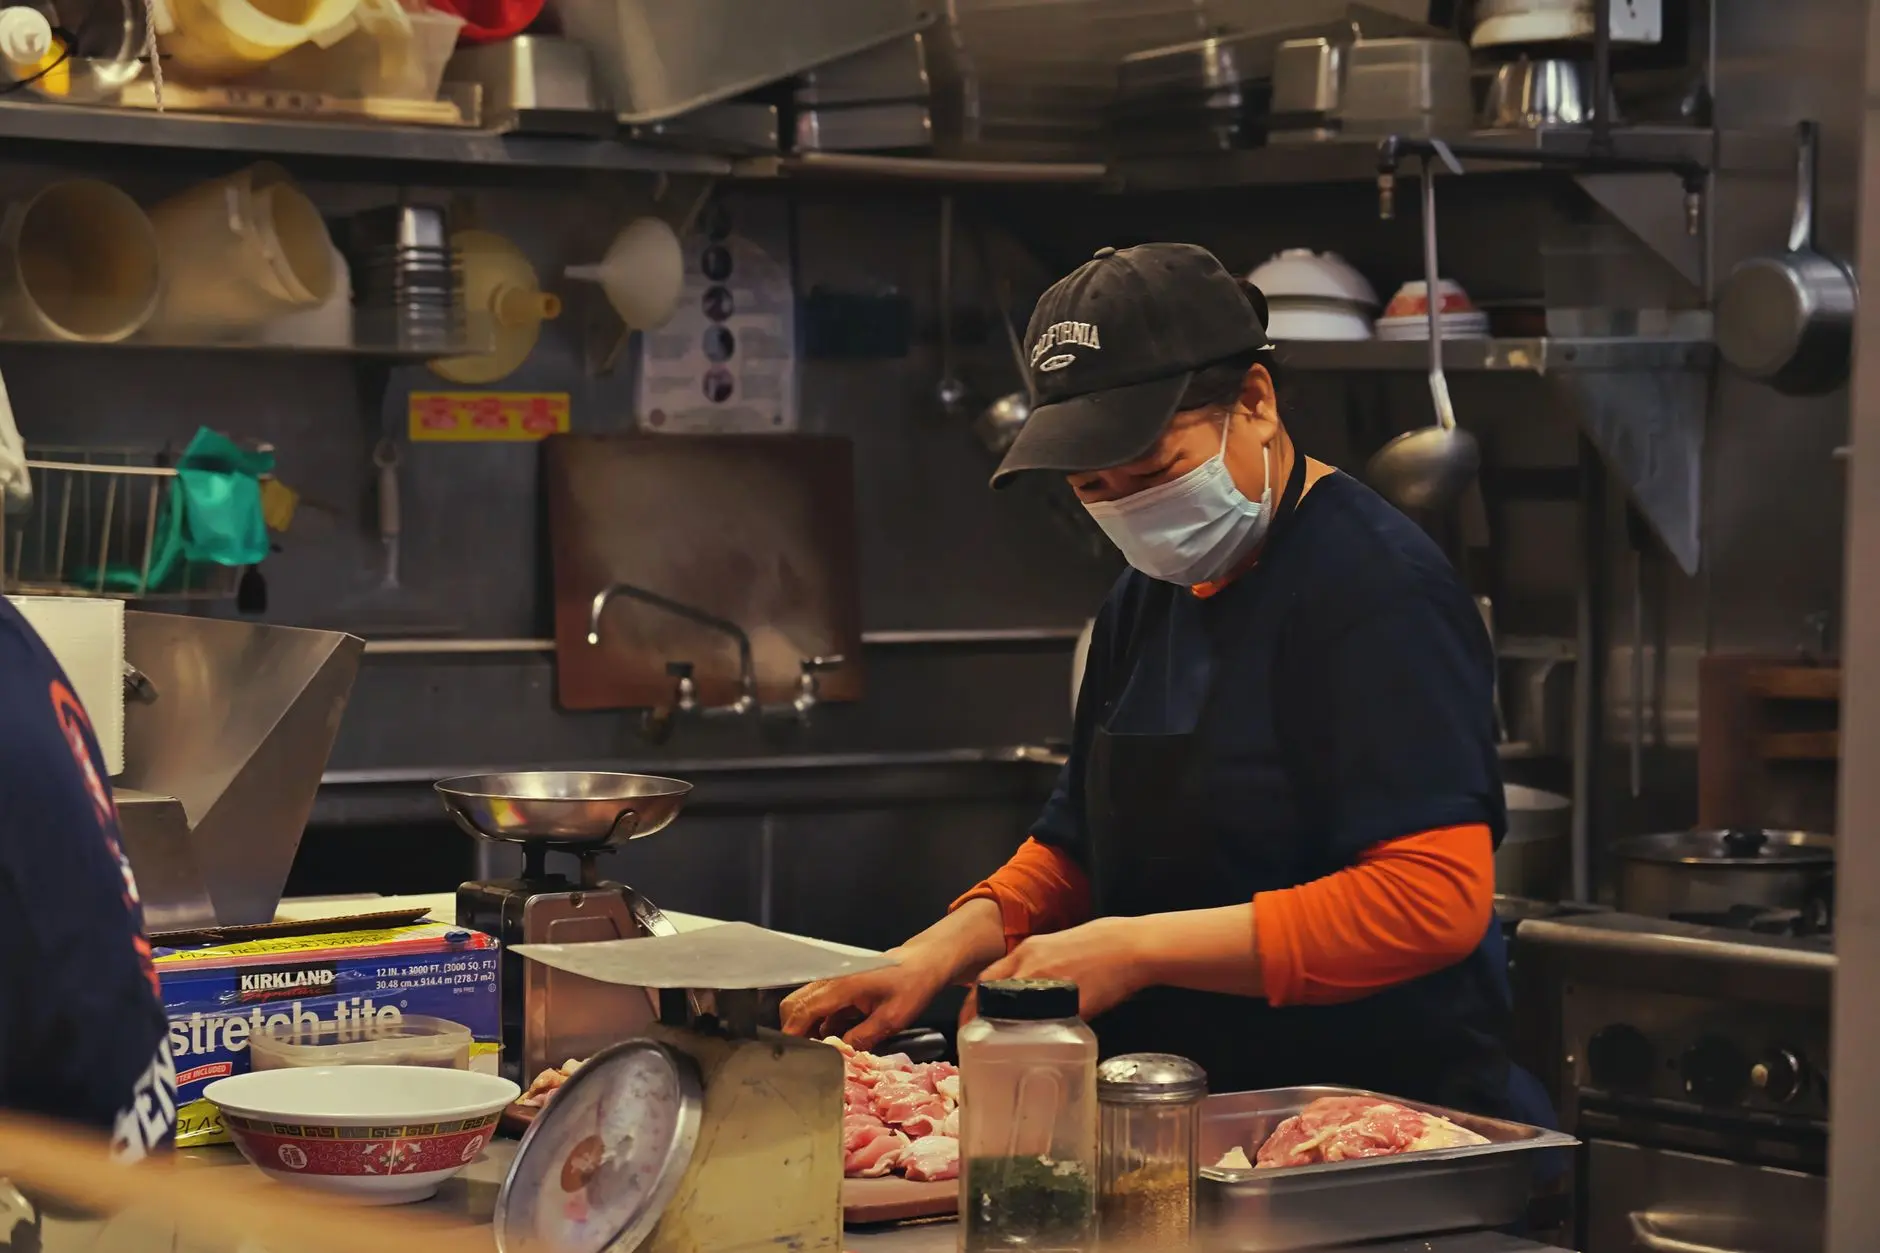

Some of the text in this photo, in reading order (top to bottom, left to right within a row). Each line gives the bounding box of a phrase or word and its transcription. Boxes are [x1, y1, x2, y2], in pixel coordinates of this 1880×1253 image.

[376, 960, 496, 977] 12 IN. x 3000 FT. (3000 SQ. FT.)
[241, 969, 333, 990] KIRKLAND
[376, 979, 398, 989] 30.48
[413, 979, 419, 987] x
[420, 976, 443, 986] 914.4
[444, 976, 452, 984] m
[454, 974, 478, 985] (278.7
[193, 1065, 227, 1078] INCLUDED
[176, 1116, 225, 1135] PLAS
